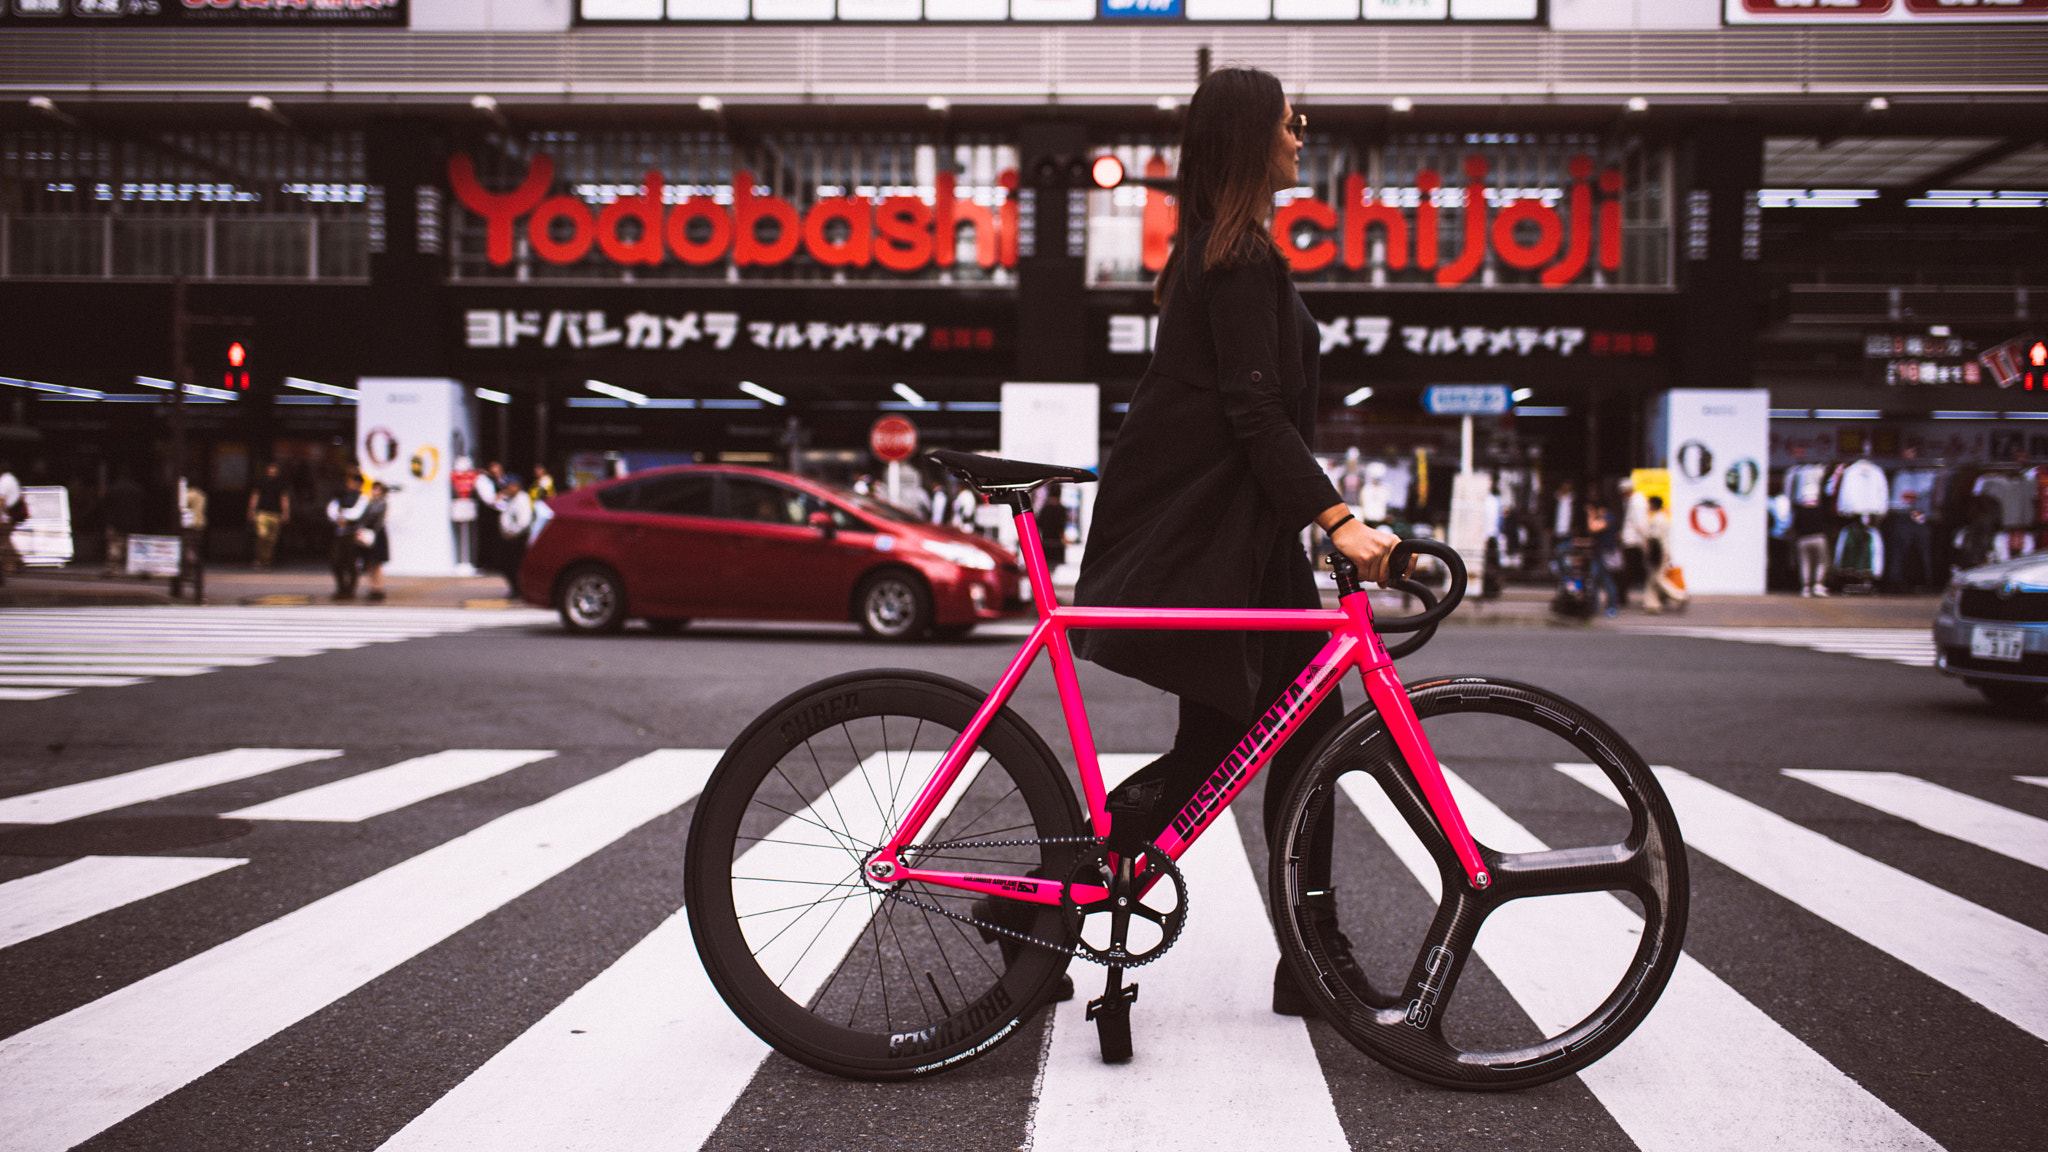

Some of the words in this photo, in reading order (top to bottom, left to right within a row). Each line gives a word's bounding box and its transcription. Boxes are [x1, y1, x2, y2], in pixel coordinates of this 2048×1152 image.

[449, 152, 1018, 271] Yodobashi
[465, 311, 739, 348] ヨドバシカメラ
[1171, 682, 1313, 843] DOSNOVENTA
[1404, 945, 1454, 1030] GT3
[976, 1024, 1012, 1052] MICHELIN
